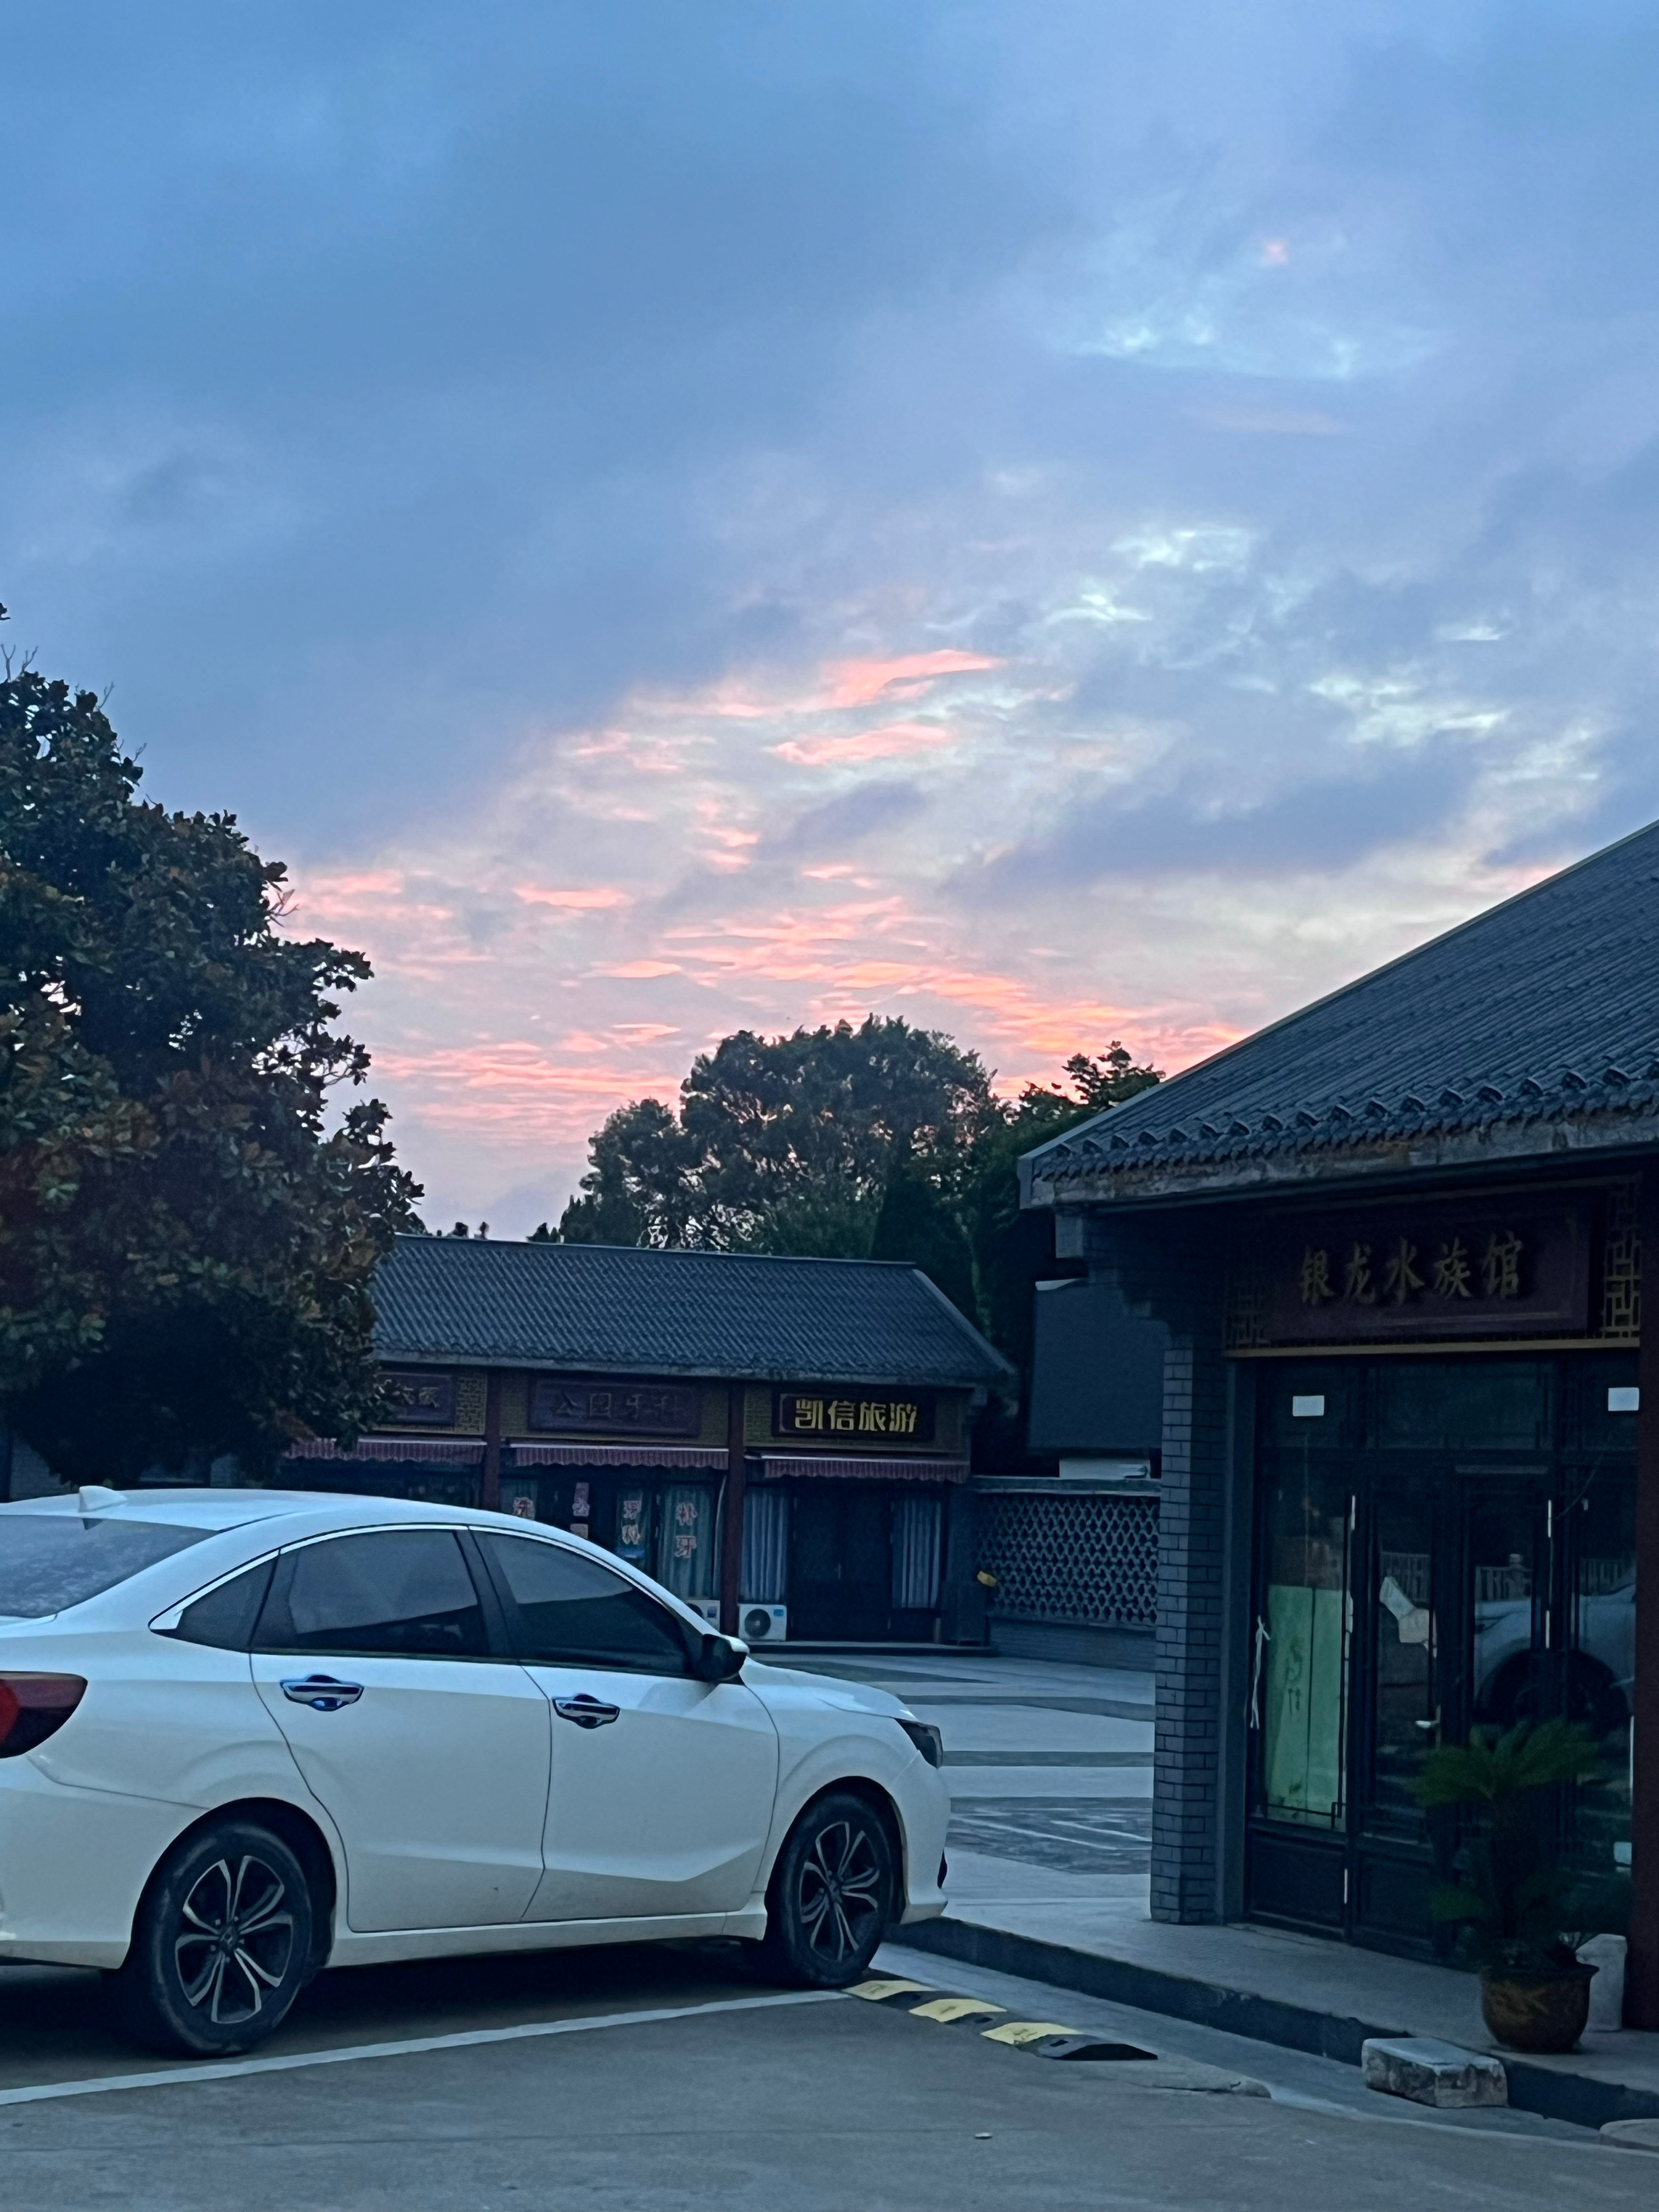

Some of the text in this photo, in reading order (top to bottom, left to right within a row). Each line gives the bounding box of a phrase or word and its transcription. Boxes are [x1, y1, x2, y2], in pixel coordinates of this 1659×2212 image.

[1299, 1229, 1525, 1306] 银龙水族馆
[794, 1397, 918, 1434] 凯信旅游
